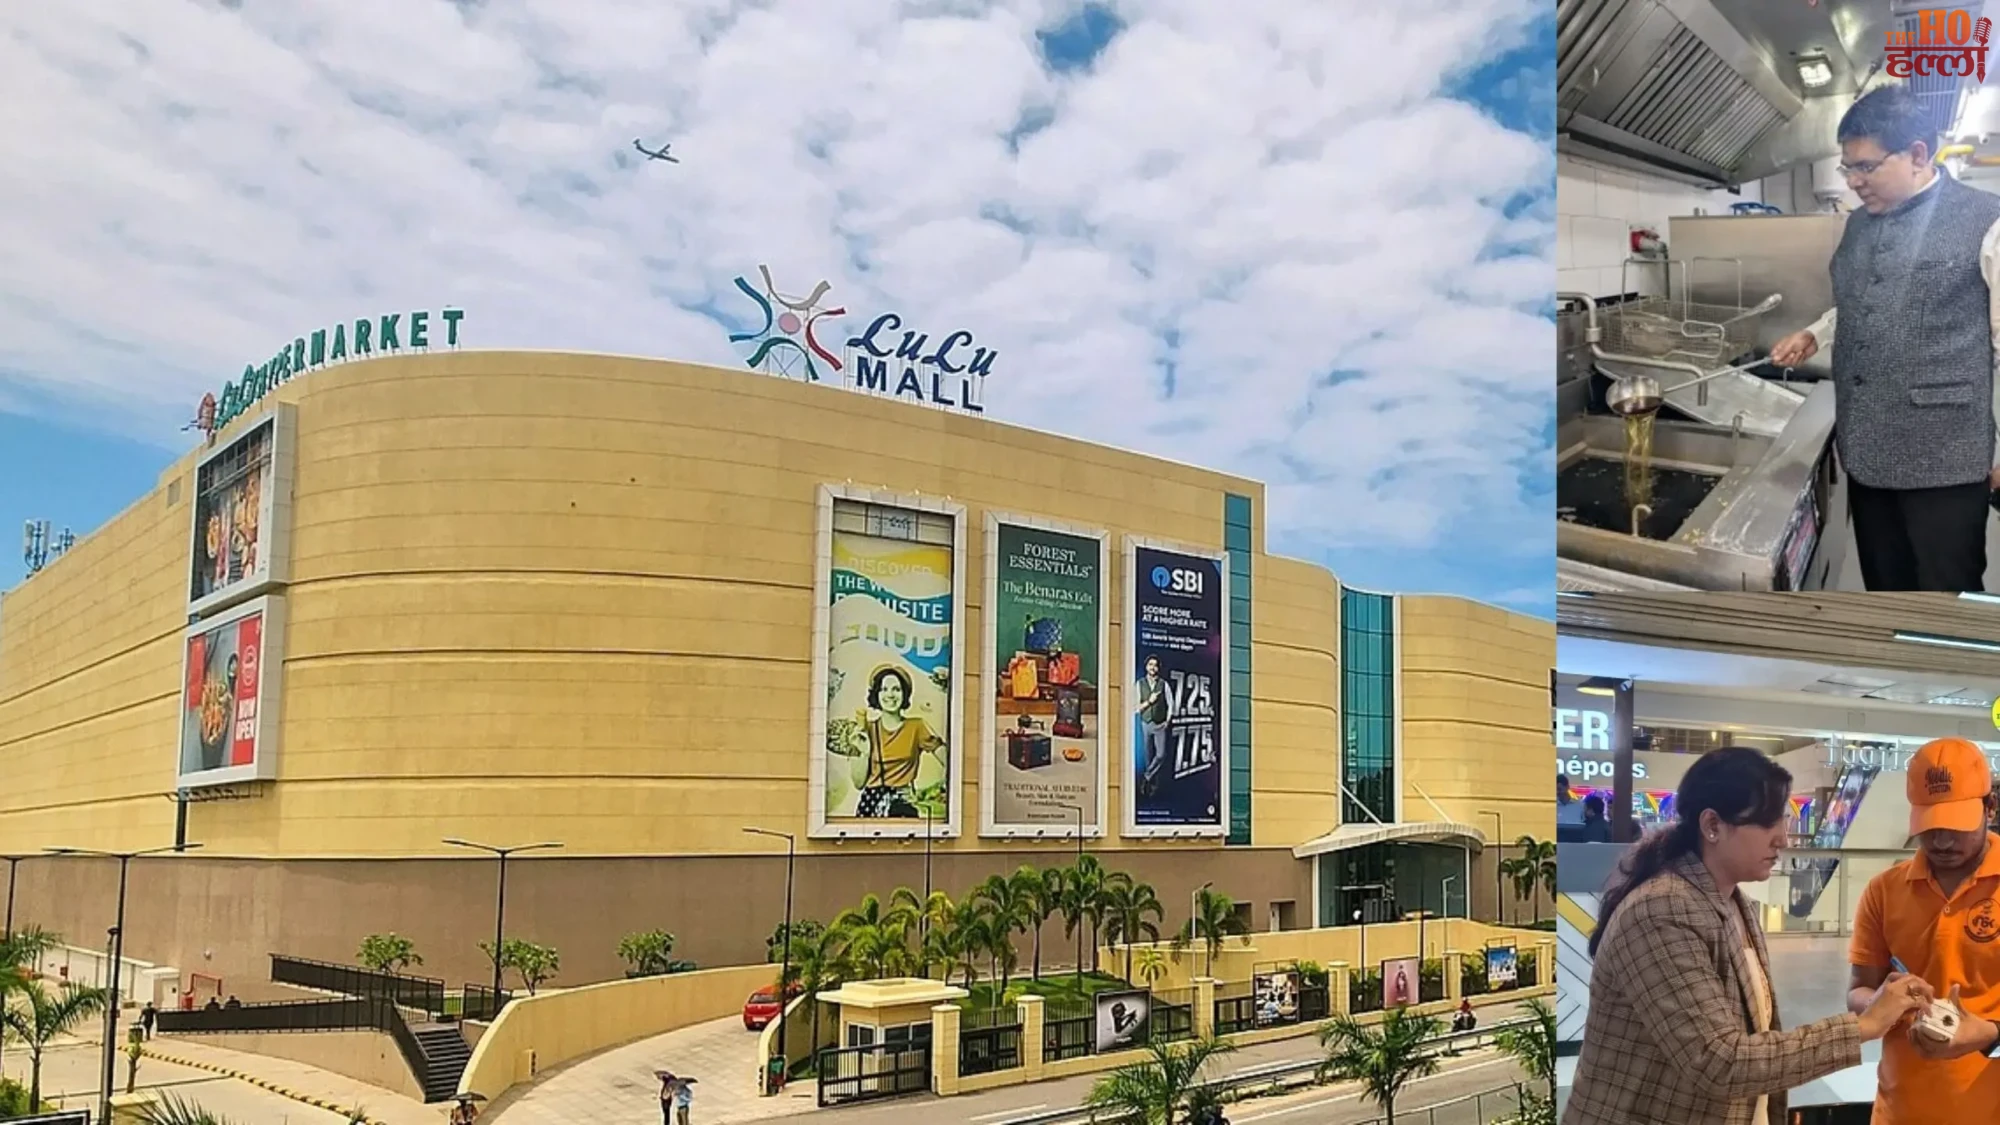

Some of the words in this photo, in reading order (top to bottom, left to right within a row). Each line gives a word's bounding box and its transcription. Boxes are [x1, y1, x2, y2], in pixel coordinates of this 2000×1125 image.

[256, 309, 464, 399] HYPERMARKET
[856, 355, 984, 412] MALL
[1024, 543, 1076, 562] FOREST
[836, 574, 866, 590] THE
[1003, 580, 1023, 594] The
[1024, 581, 1073, 600] Benaras
[1171, 569, 1203, 593] SBI
[835, 593, 943, 621] ISITE
[1142, 605, 1168, 616] SCORE
[1169, 608, 1191, 618] MORE
[1142, 614, 1152, 623] AT
[1159, 616, 1188, 627] HIGHER
[1189, 619, 1208, 629] RATE
